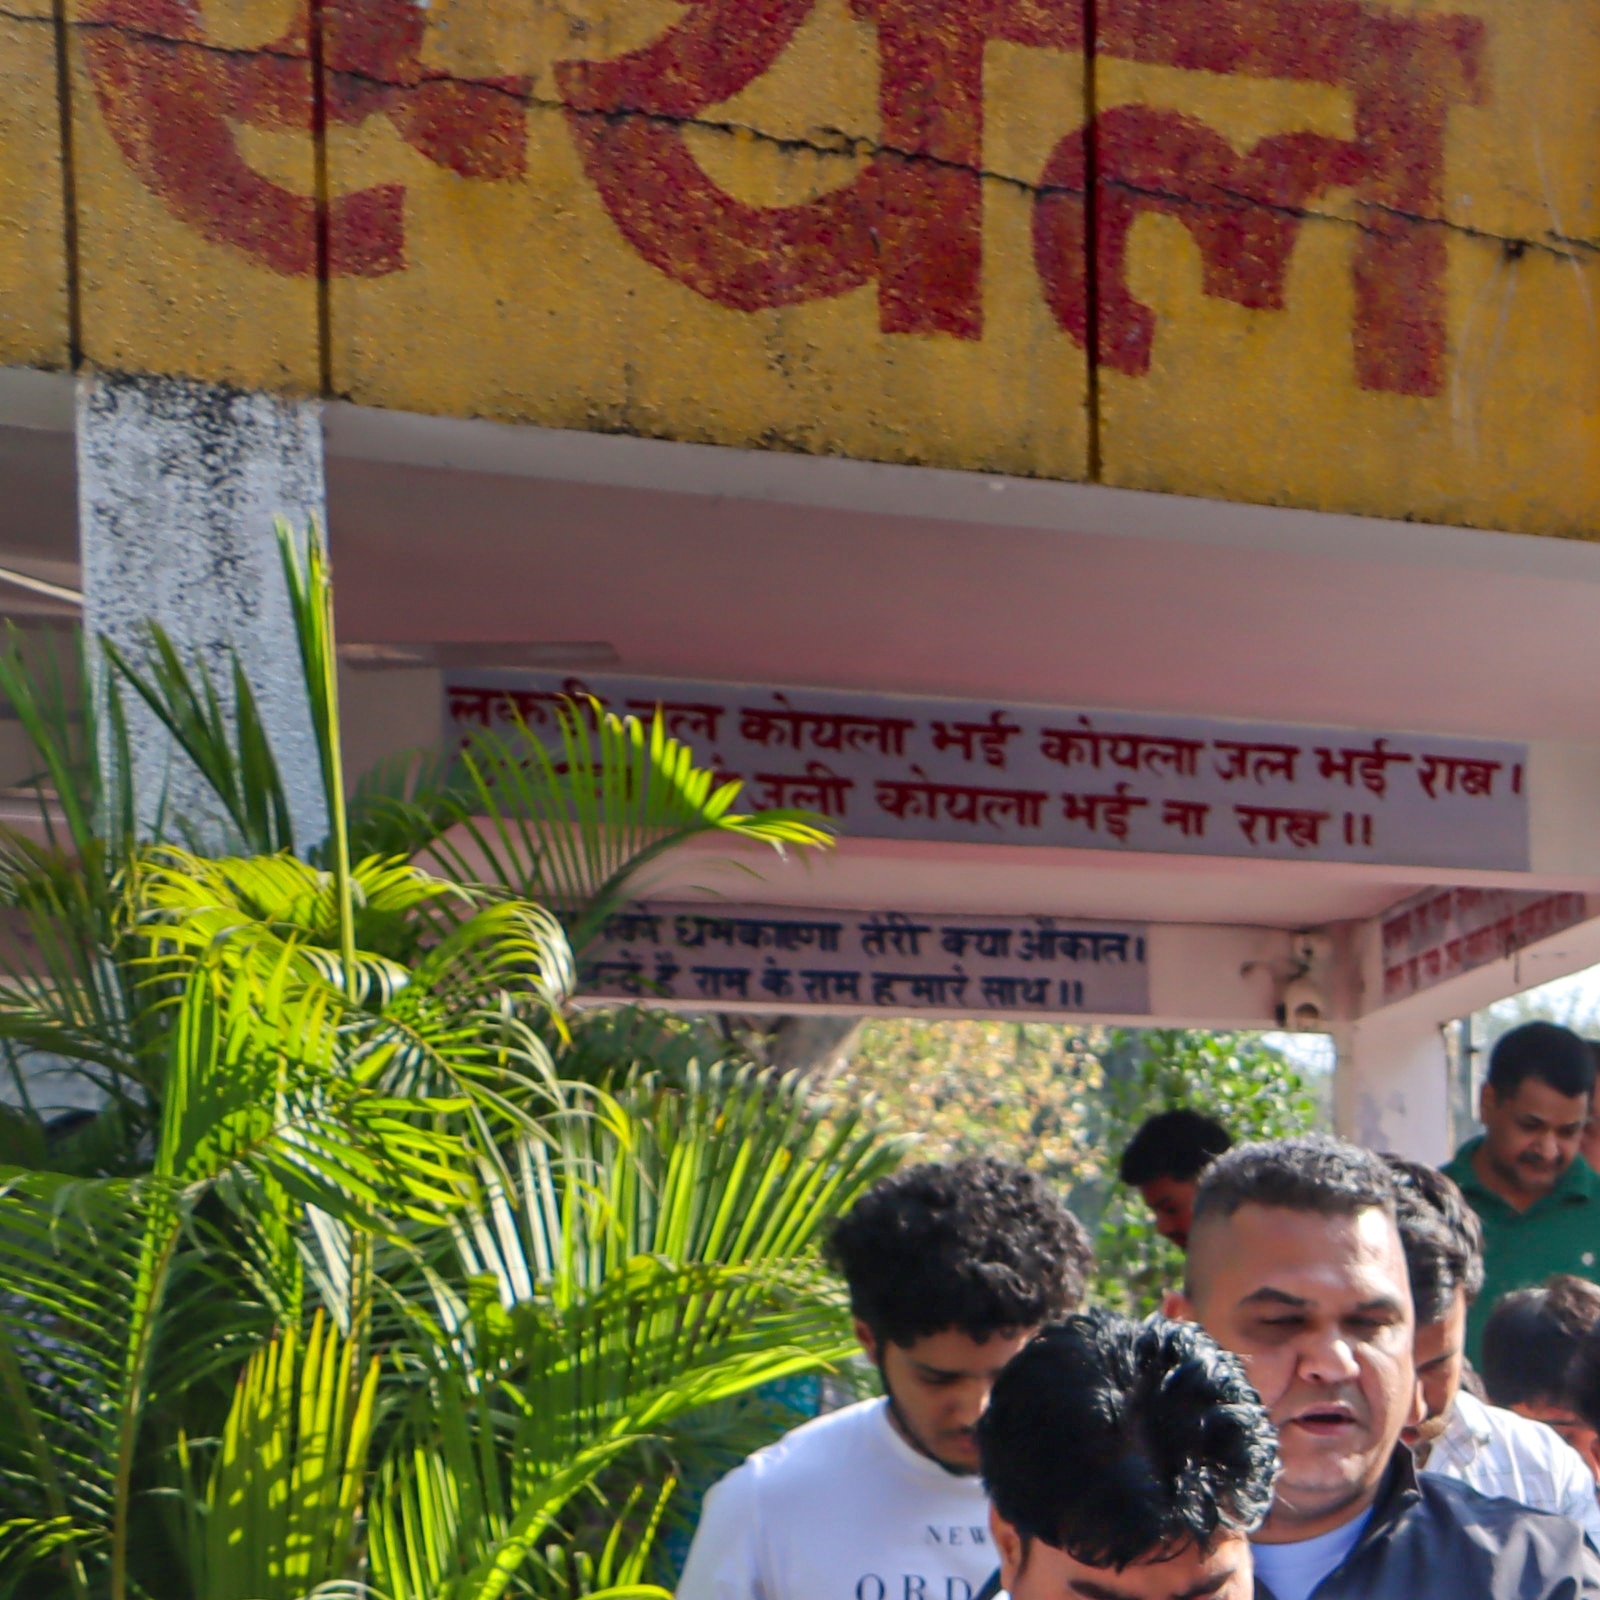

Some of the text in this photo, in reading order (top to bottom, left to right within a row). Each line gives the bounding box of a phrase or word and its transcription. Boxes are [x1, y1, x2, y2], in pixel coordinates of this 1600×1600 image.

[740, 692, 914, 758] कोयला
[928, 709, 1021, 770] भई
[1040, 713, 1204, 778] कोयला
[1313, 737, 1413, 799] भई
[1416, 754, 1501, 800] राख
[874, 763, 1049, 829] कोयला
[1062, 782, 1147, 844] भई
[1162, 799, 1209, 838] ना
[1235, 804, 1330, 847] राख
